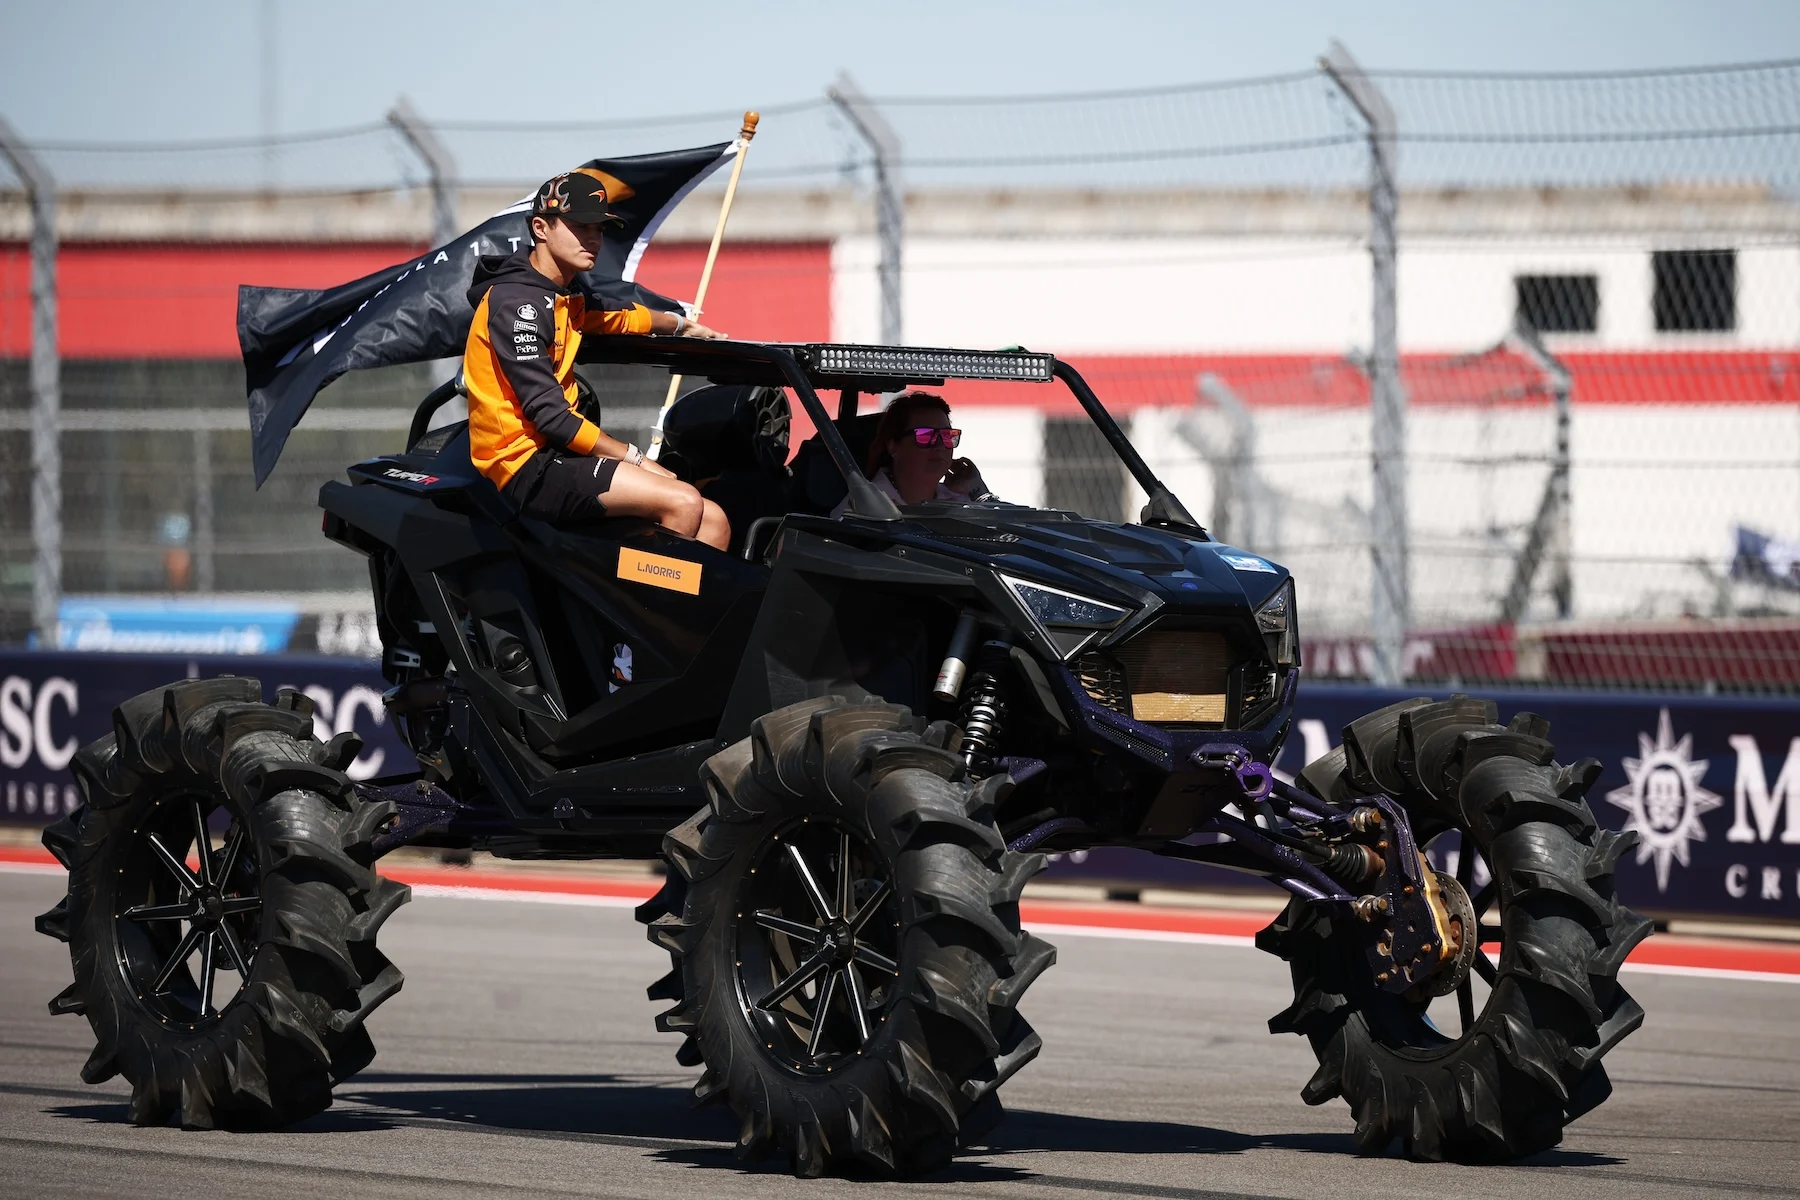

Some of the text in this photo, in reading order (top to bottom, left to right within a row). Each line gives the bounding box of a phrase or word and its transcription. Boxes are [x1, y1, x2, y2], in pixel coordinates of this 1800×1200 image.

[516, 322, 536, 331] Hilton
[514, 333, 537, 344] okta
[516, 345, 538, 353] FxPro
[637, 562, 682, 580] L.NORRIS
[1725, 863, 1800, 900] CR
